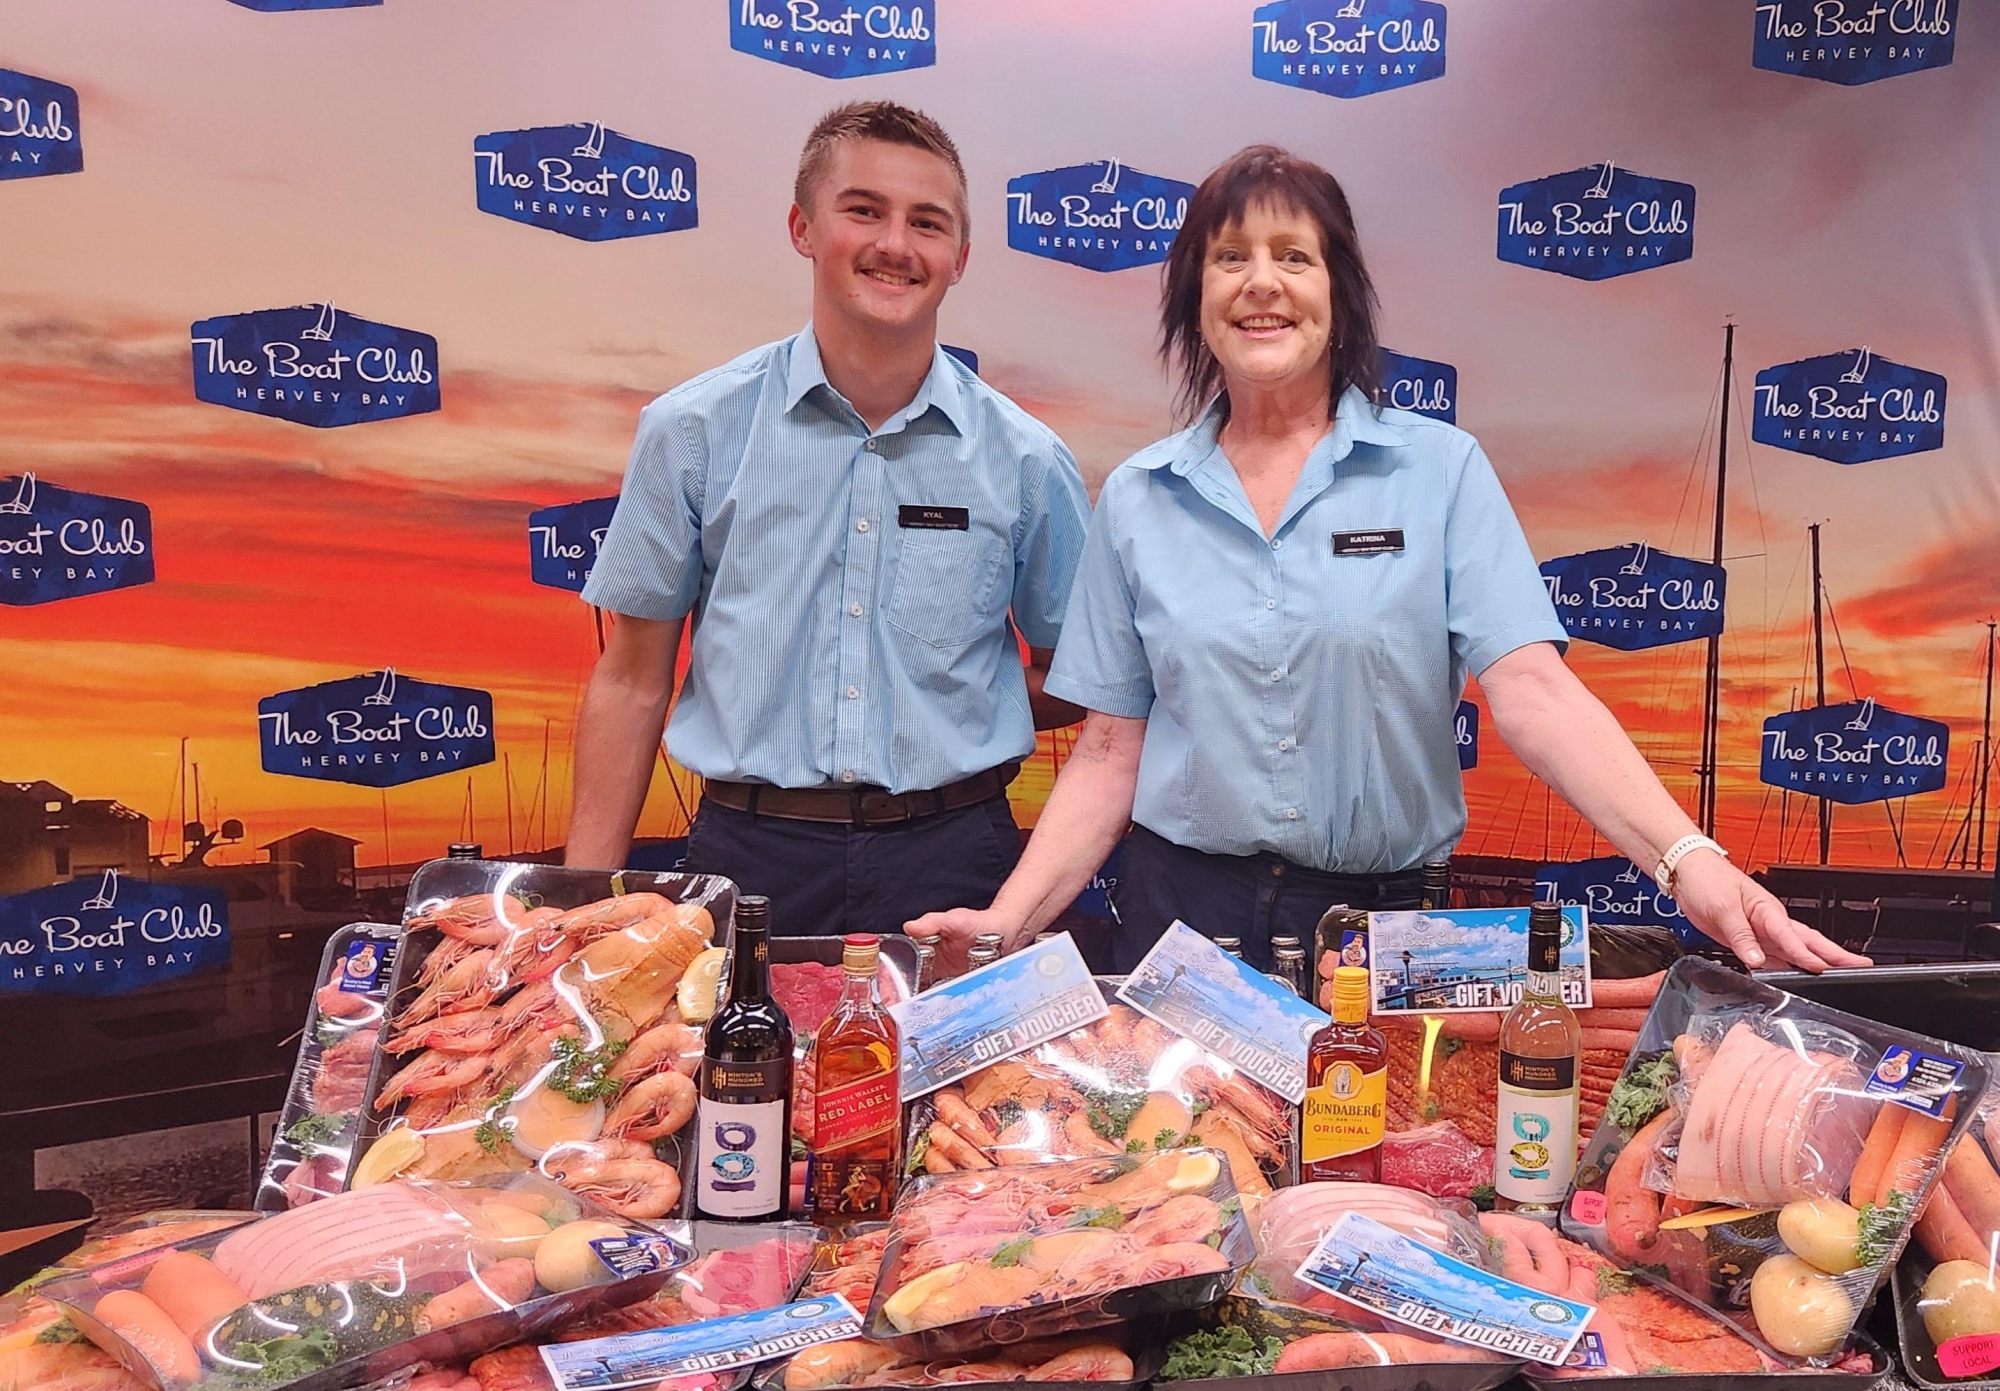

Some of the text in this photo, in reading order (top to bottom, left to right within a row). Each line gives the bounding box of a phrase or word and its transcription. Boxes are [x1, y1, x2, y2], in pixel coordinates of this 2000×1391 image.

[786, 0, 862, 36] Boat
[864, 5, 930, 41] Club
[1756, 0, 1950, 39] The Boat Club
[764, 39, 906, 60] HERVEY BAY
[1252, 18, 1440, 54] The Boat Club
[1786, 46, 1925, 62] HERVEY BAY
[1283, 64, 1417, 75] HERVEY BAY
[474, 152, 691, 203] The Boat Club
[514, 200, 668, 223] HERVEY BAY
[1007, 192, 1056, 225] The
[1060, 195, 1130, 229] Boat
[1498, 200, 1688, 238] The Boat Club
[1039, 237, 1171, 251] HERVEY BAY
[1528, 246, 1664, 257] HERVEY BAY
[191, 338, 432, 385] The Boat Club
[237, 387, 405, 406] HERVEY BAY
[1391, 379, 1451, 410] Club
[1755, 386, 1939, 424] The Boat Club
[1784, 429, 1916, 445] HERVEY BAY
[923, 511, 944, 519] KYAL
[59, 518, 145, 556] Club
[528, 526, 586, 559] The
[1350, 534, 1386, 544] KATRINA
[66, 567, 115, 580] BAY
[1589, 577, 1656, 609] Boat
[1659, 579, 1720, 611] Club
[1566, 618, 1696, 631] HERVEY BAY
[258, 706, 487, 746] The Boat Club
[302, 750, 462, 766] HERVEY BAY
[1762, 732, 1943, 767] The Boat Club
[1790, 771, 1919, 786] HERVEY BAY
[1585, 884, 1650, 916] Boat
[40, 915, 136, 954] Boat
[140, 903, 222, 943] Club
[1376, 932, 1400, 948] The
[1401, 934, 1435, 947] Boat
[13, 951, 194, 979] HERVEY BAY
[1456, 980, 1584, 1007] GIFT VOER
[903, 1015, 934, 1033] Boat
[973, 994, 1100, 1061] GIFT VOUCHER
[1192, 1018, 1304, 1096] GIFT VOUCHER
[818, 1108, 846, 1123] RED
[848, 1092, 892, 1113] LABEL
[822, 1094, 855, 1110] JOHNNIE
[1305, 1096, 1382, 1118] BUNDABERG
[1313, 1124, 1371, 1135] ORIGINAL
[1398, 1302, 1448, 1330] GIFT
[1449, 1318, 1560, 1361] VOUCHER
[683, 1322, 862, 1372] GIFT VOUCHER
[1953, 1340, 1993, 1355] SUPPORT
[1963, 1355, 1992, 1369] LOCAL
